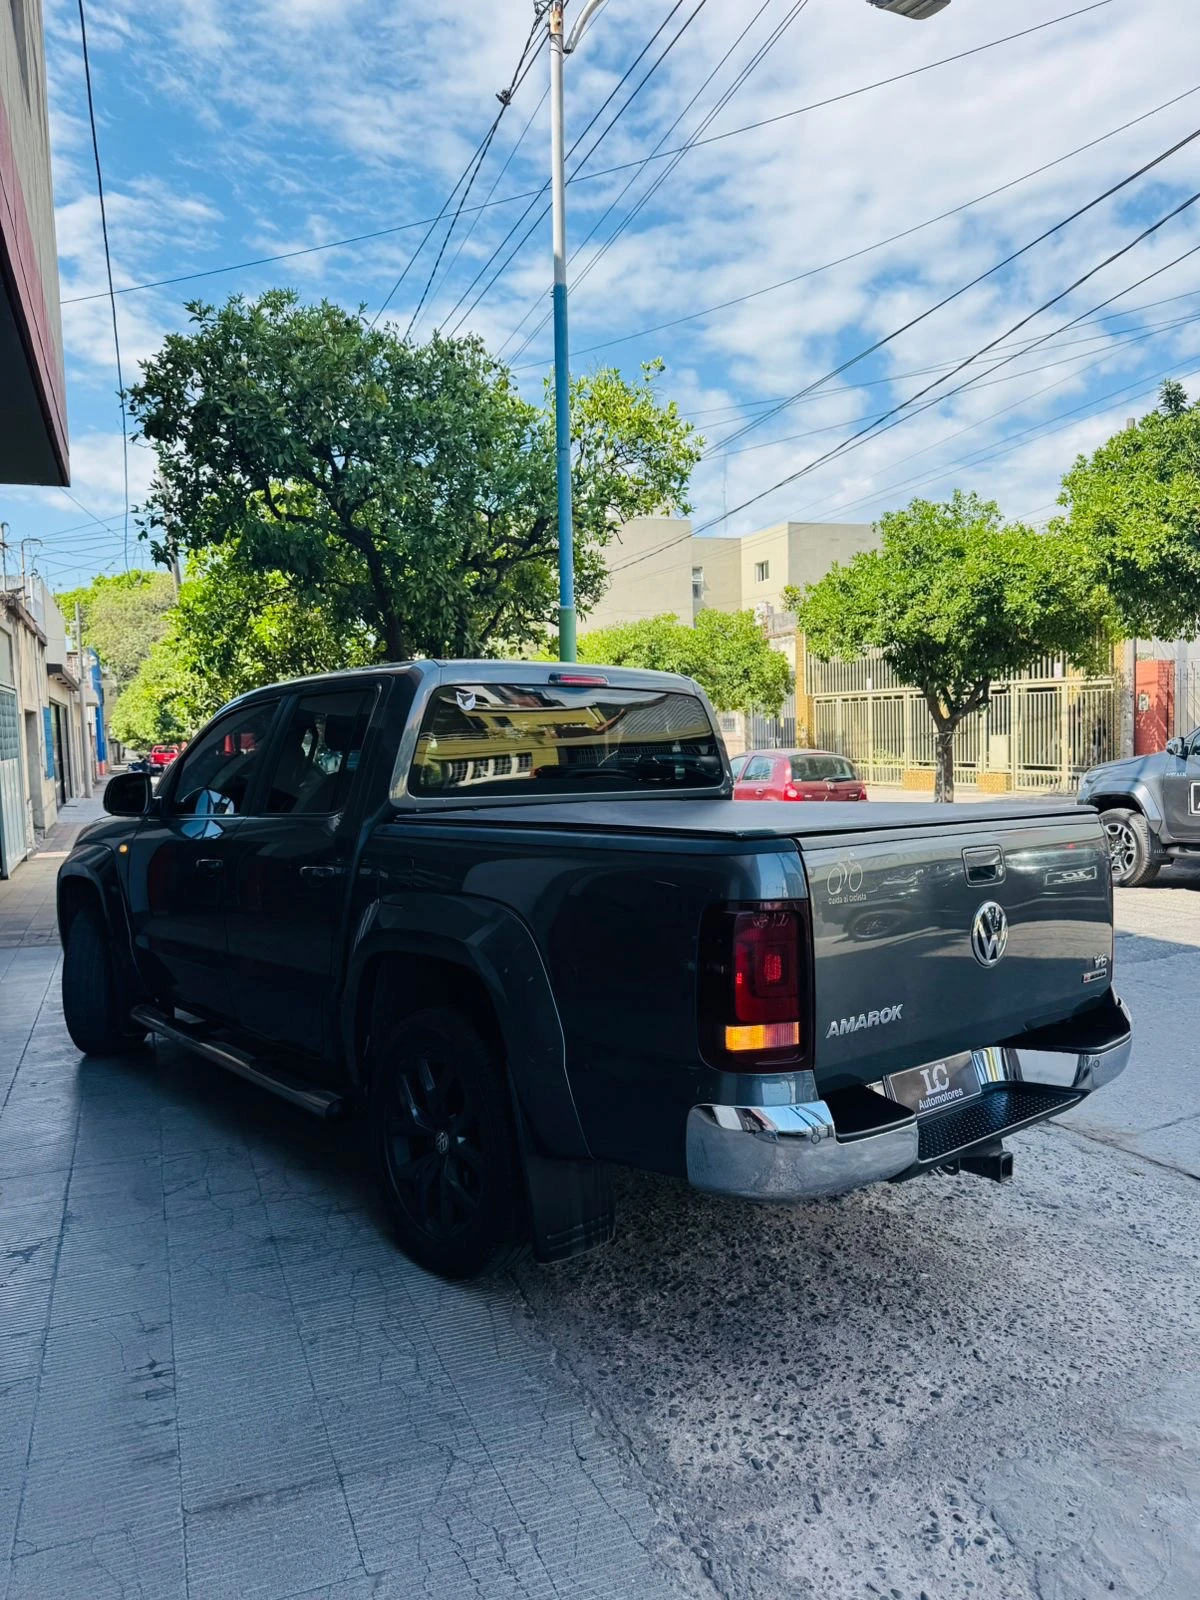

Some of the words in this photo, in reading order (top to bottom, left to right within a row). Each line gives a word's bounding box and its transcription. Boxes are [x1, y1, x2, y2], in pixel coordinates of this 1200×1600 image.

[826, 1004, 904, 1039] AMAROK
[920, 1063, 950, 1096] LC
[918, 1088, 964, 1110] Automotores
